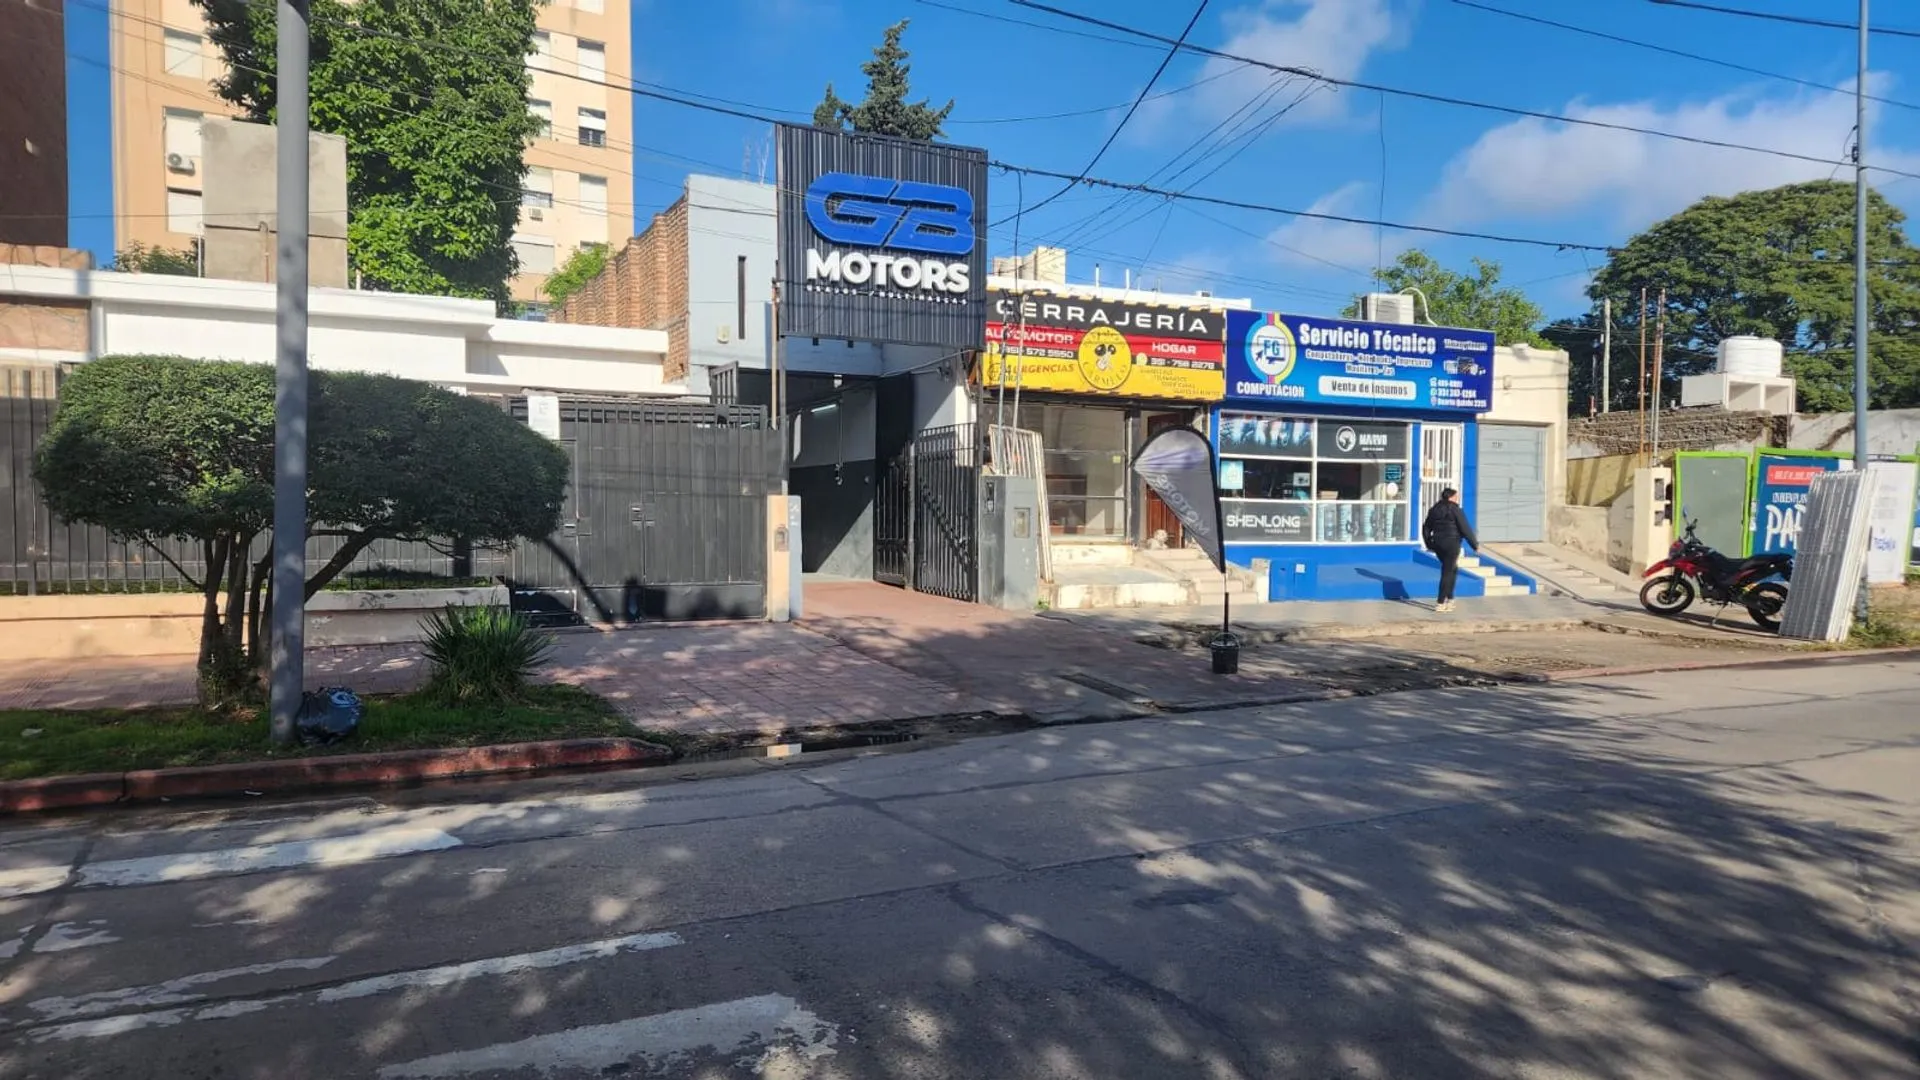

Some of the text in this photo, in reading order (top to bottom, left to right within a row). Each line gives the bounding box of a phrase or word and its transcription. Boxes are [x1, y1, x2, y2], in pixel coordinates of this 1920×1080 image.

[805, 171, 976, 255] GB
[806, 248, 970, 294] MOTORS
[996, 299, 1208, 334] CERRAJERÍA
[1152, 341, 1197, 355] HOGAR
[1263, 339, 1281, 356] FG
[1300, 323, 1370, 350] Servicio
[1373, 328, 1437, 355] Técnico
[1331, 380, 1356, 393] Venta
[1359, 381, 1370, 394] de
[1226, 514, 1301, 528] SHENLONG
